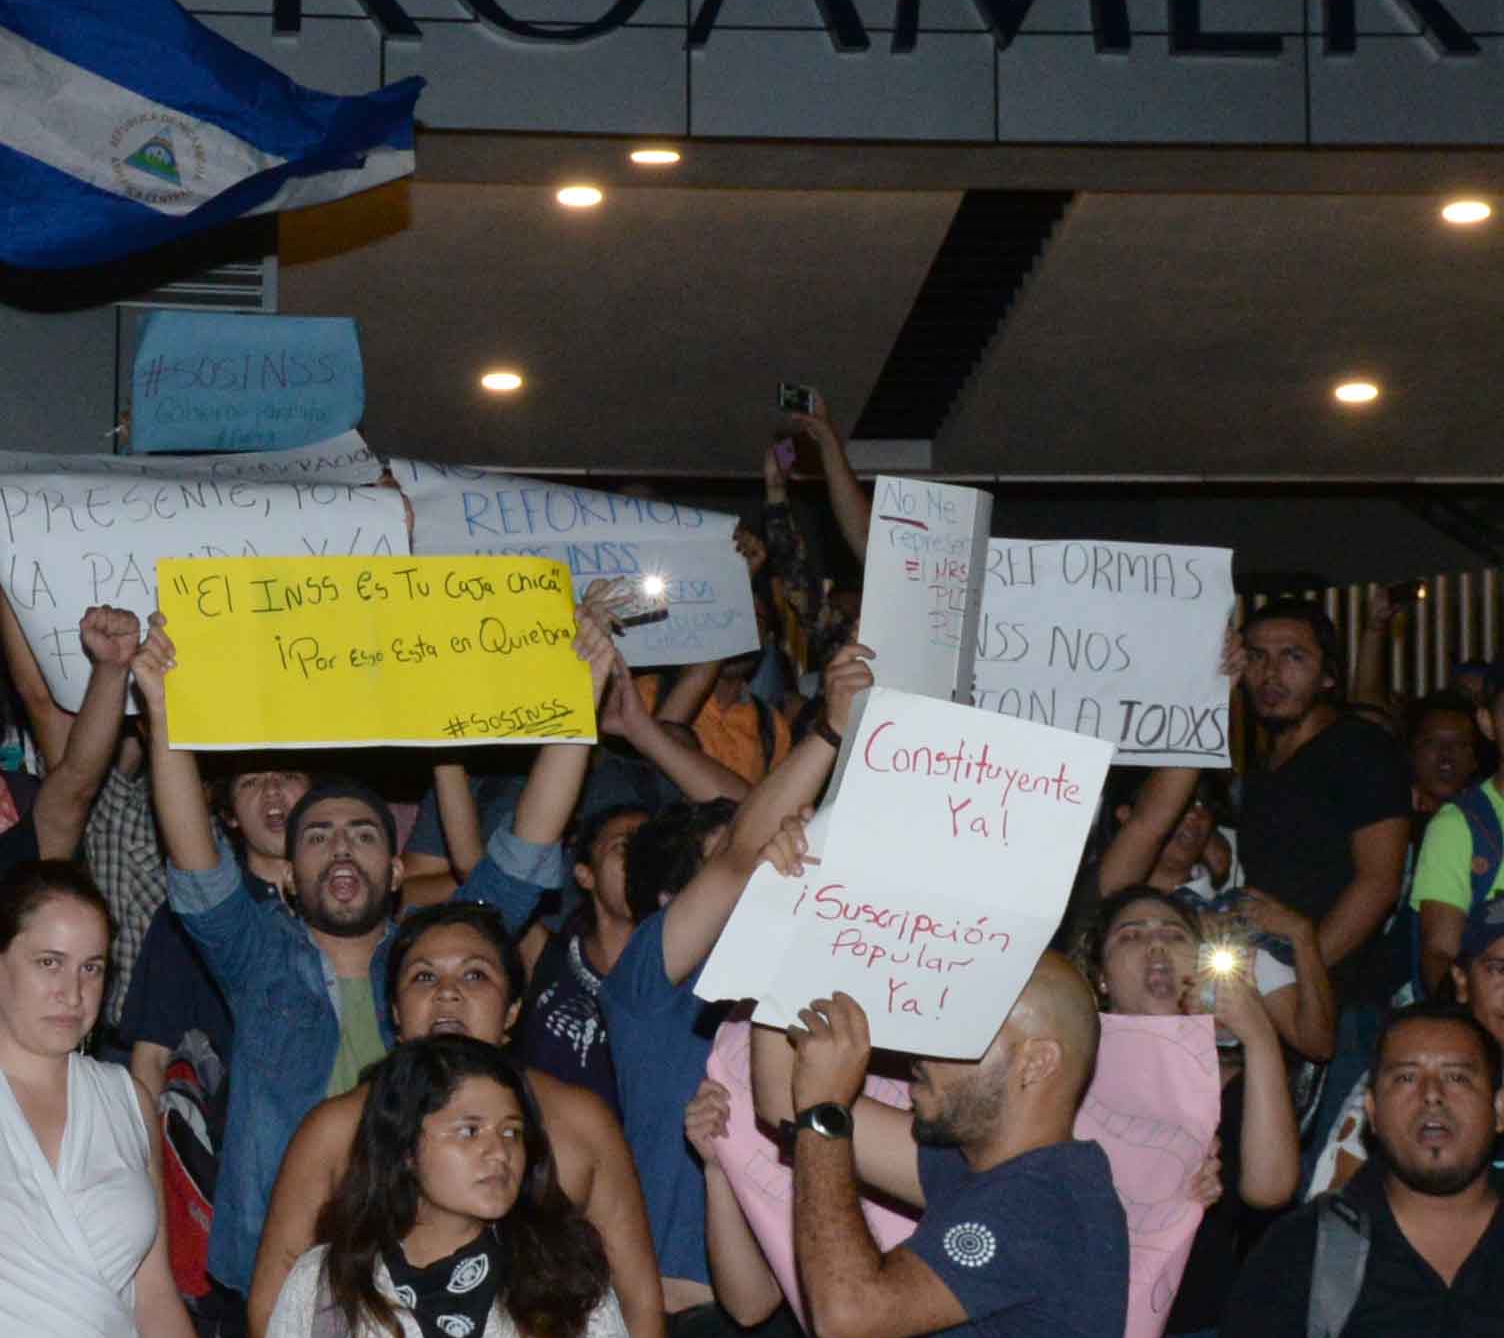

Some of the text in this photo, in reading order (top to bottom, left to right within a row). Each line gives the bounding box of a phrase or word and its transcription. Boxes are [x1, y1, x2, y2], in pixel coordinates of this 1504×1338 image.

[250, 576, 341, 613] INSS
[392, 568, 431, 599] Tu
[450, 636, 473, 654] en
[1048, 625, 1131, 672] NOS
[1119, 699, 1229, 751] TODXS
[864, 722, 1083, 806] Constituyente
[947, 795, 1010, 845] Ya!
[887, 981, 949, 1015] Ya!
